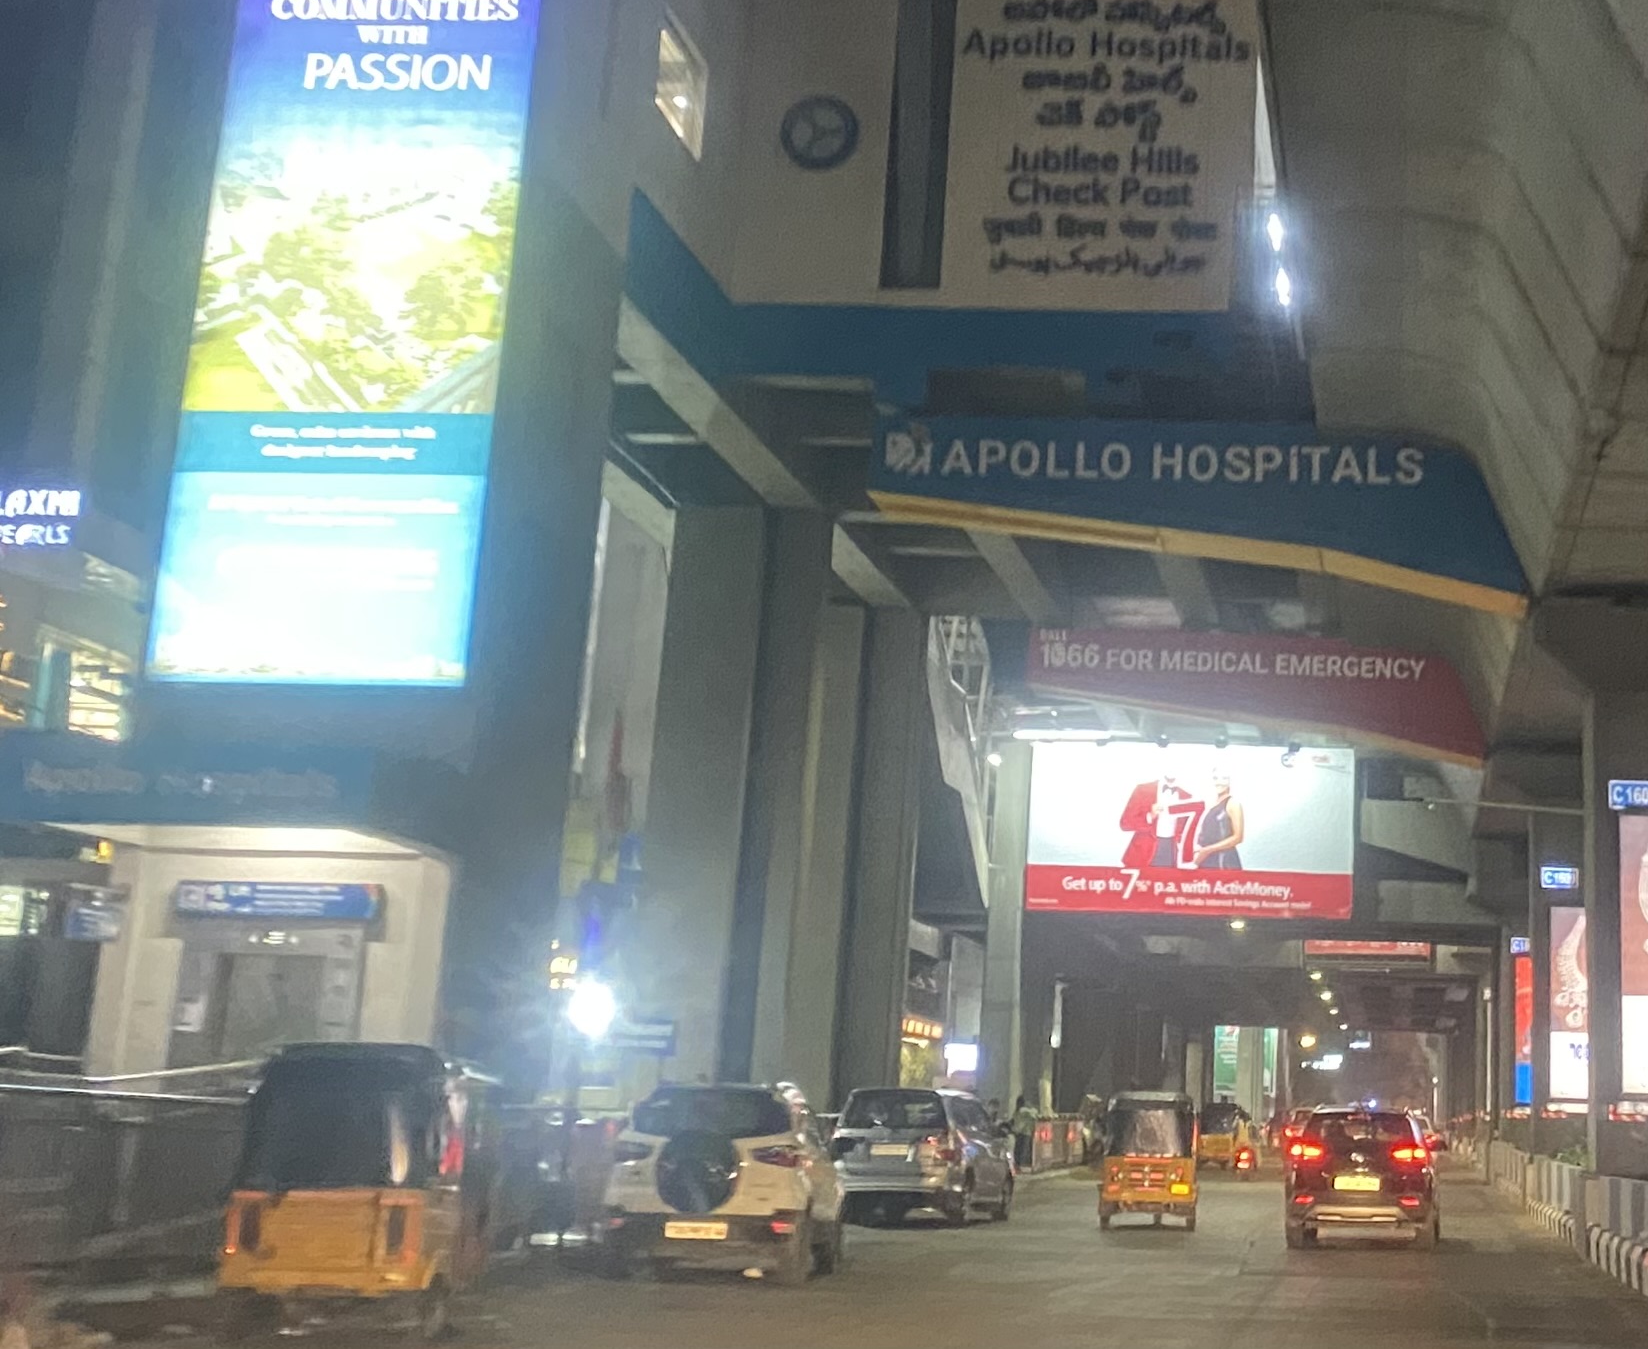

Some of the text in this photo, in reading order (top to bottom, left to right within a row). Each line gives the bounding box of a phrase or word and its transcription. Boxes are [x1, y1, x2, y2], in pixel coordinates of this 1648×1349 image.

[356, 25, 428, 45] WITH
[963, 28, 1250, 65] Apollo Hospitals
[303, 53, 492, 91] PASSION
[1005, 145, 1200, 175] Jubilee Hills
[1008, 176, 1192, 207] Check Post
[940, 439, 1425, 486] APOLLO HOSPITALS
[0, 524, 71, 546] EARLS
[1042, 643, 1425, 681] 1066 FOR MEDICAL EMERGENCY
[1062, 876, 1086, 891] Get
[1088, 879, 1107, 895] up
[1108, 877, 1123, 891] to
[1153, 881, 1179, 896] p.a.
[1181, 879, 1211, 894] with
